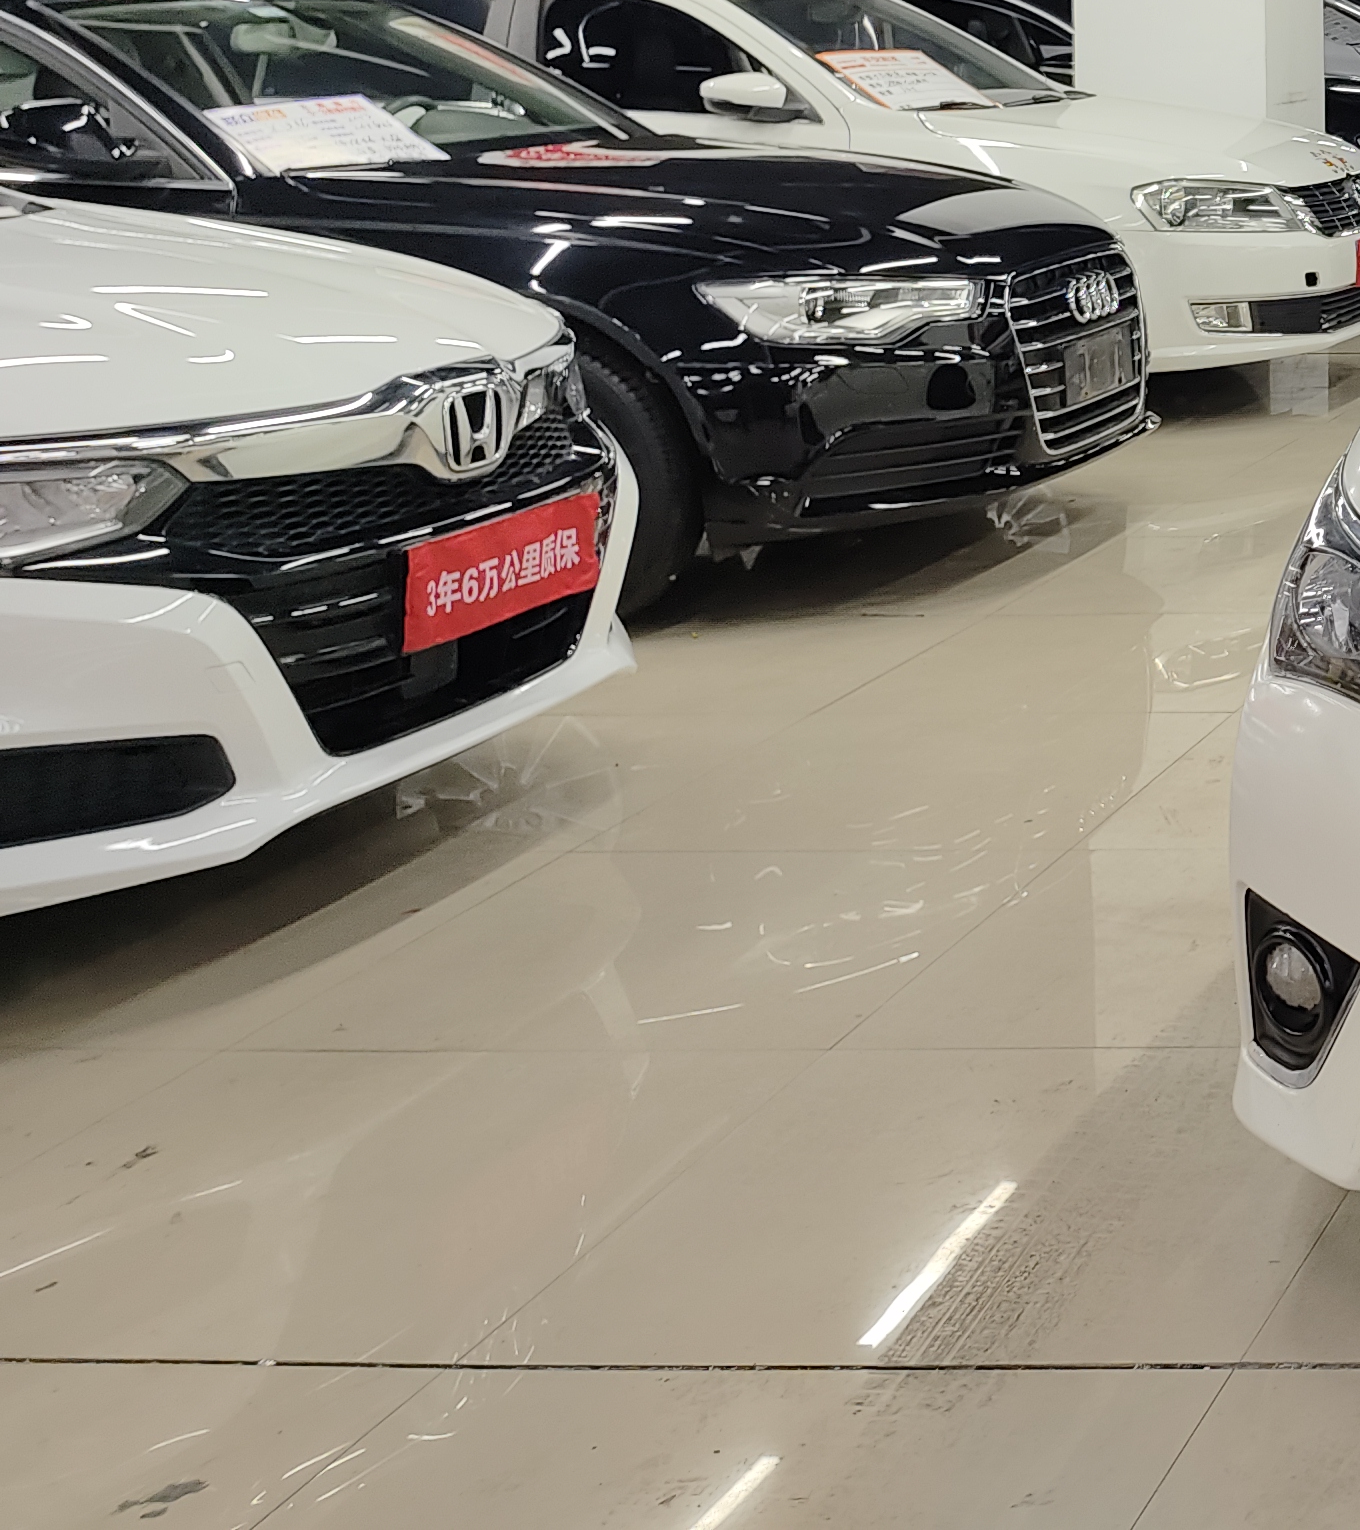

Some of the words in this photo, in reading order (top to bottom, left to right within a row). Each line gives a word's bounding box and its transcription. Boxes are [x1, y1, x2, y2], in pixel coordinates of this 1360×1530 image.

[426, 527, 581, 617] 3年6万公里质保
